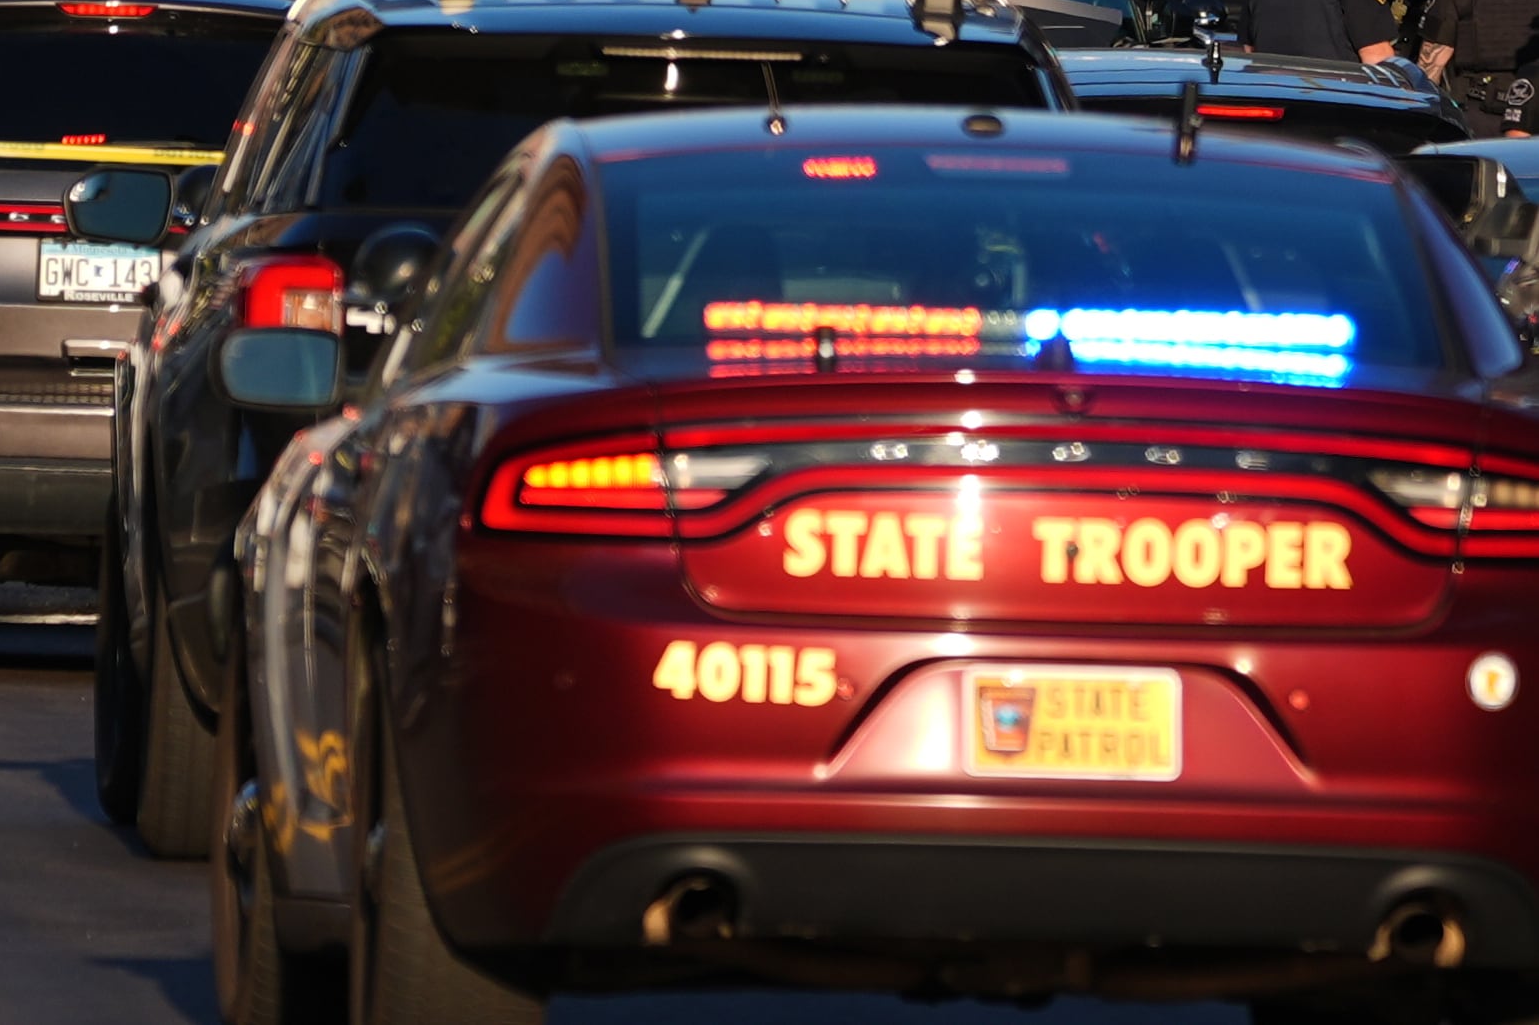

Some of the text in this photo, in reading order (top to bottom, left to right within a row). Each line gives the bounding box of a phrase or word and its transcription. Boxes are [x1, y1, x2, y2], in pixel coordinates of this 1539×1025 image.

[45, 258, 154, 289] GWC 143
[63, 290, 135, 303] ROSEVILLE
[782, 509, 1353, 589] STATE TROOPER
[652, 639, 838, 707] 40115
[1045, 686, 1149, 721] STATE
[1035, 729, 1172, 767] PATROL
